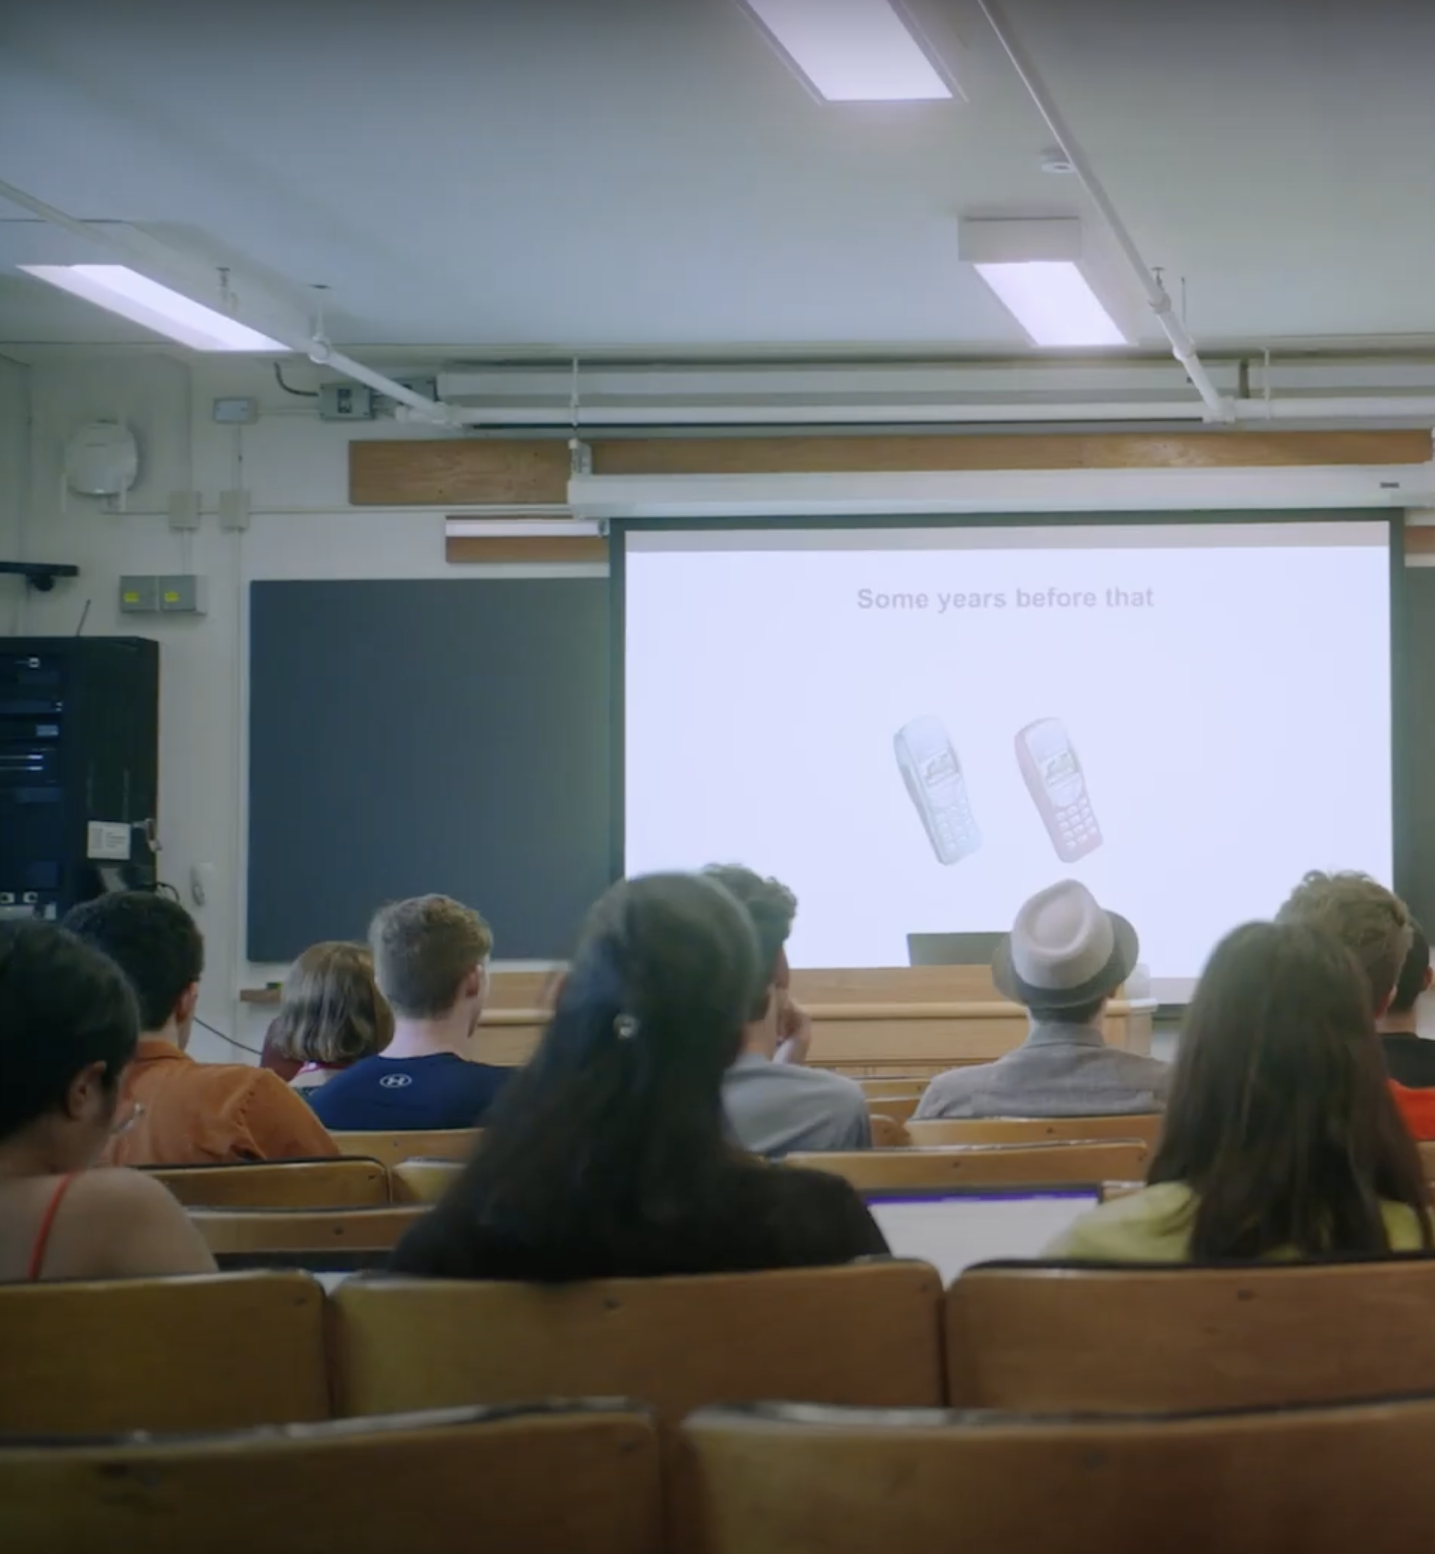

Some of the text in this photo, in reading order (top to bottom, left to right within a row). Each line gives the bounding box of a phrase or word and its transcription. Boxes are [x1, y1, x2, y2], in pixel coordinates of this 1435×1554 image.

[857, 586, 1155, 614] Some years before that
